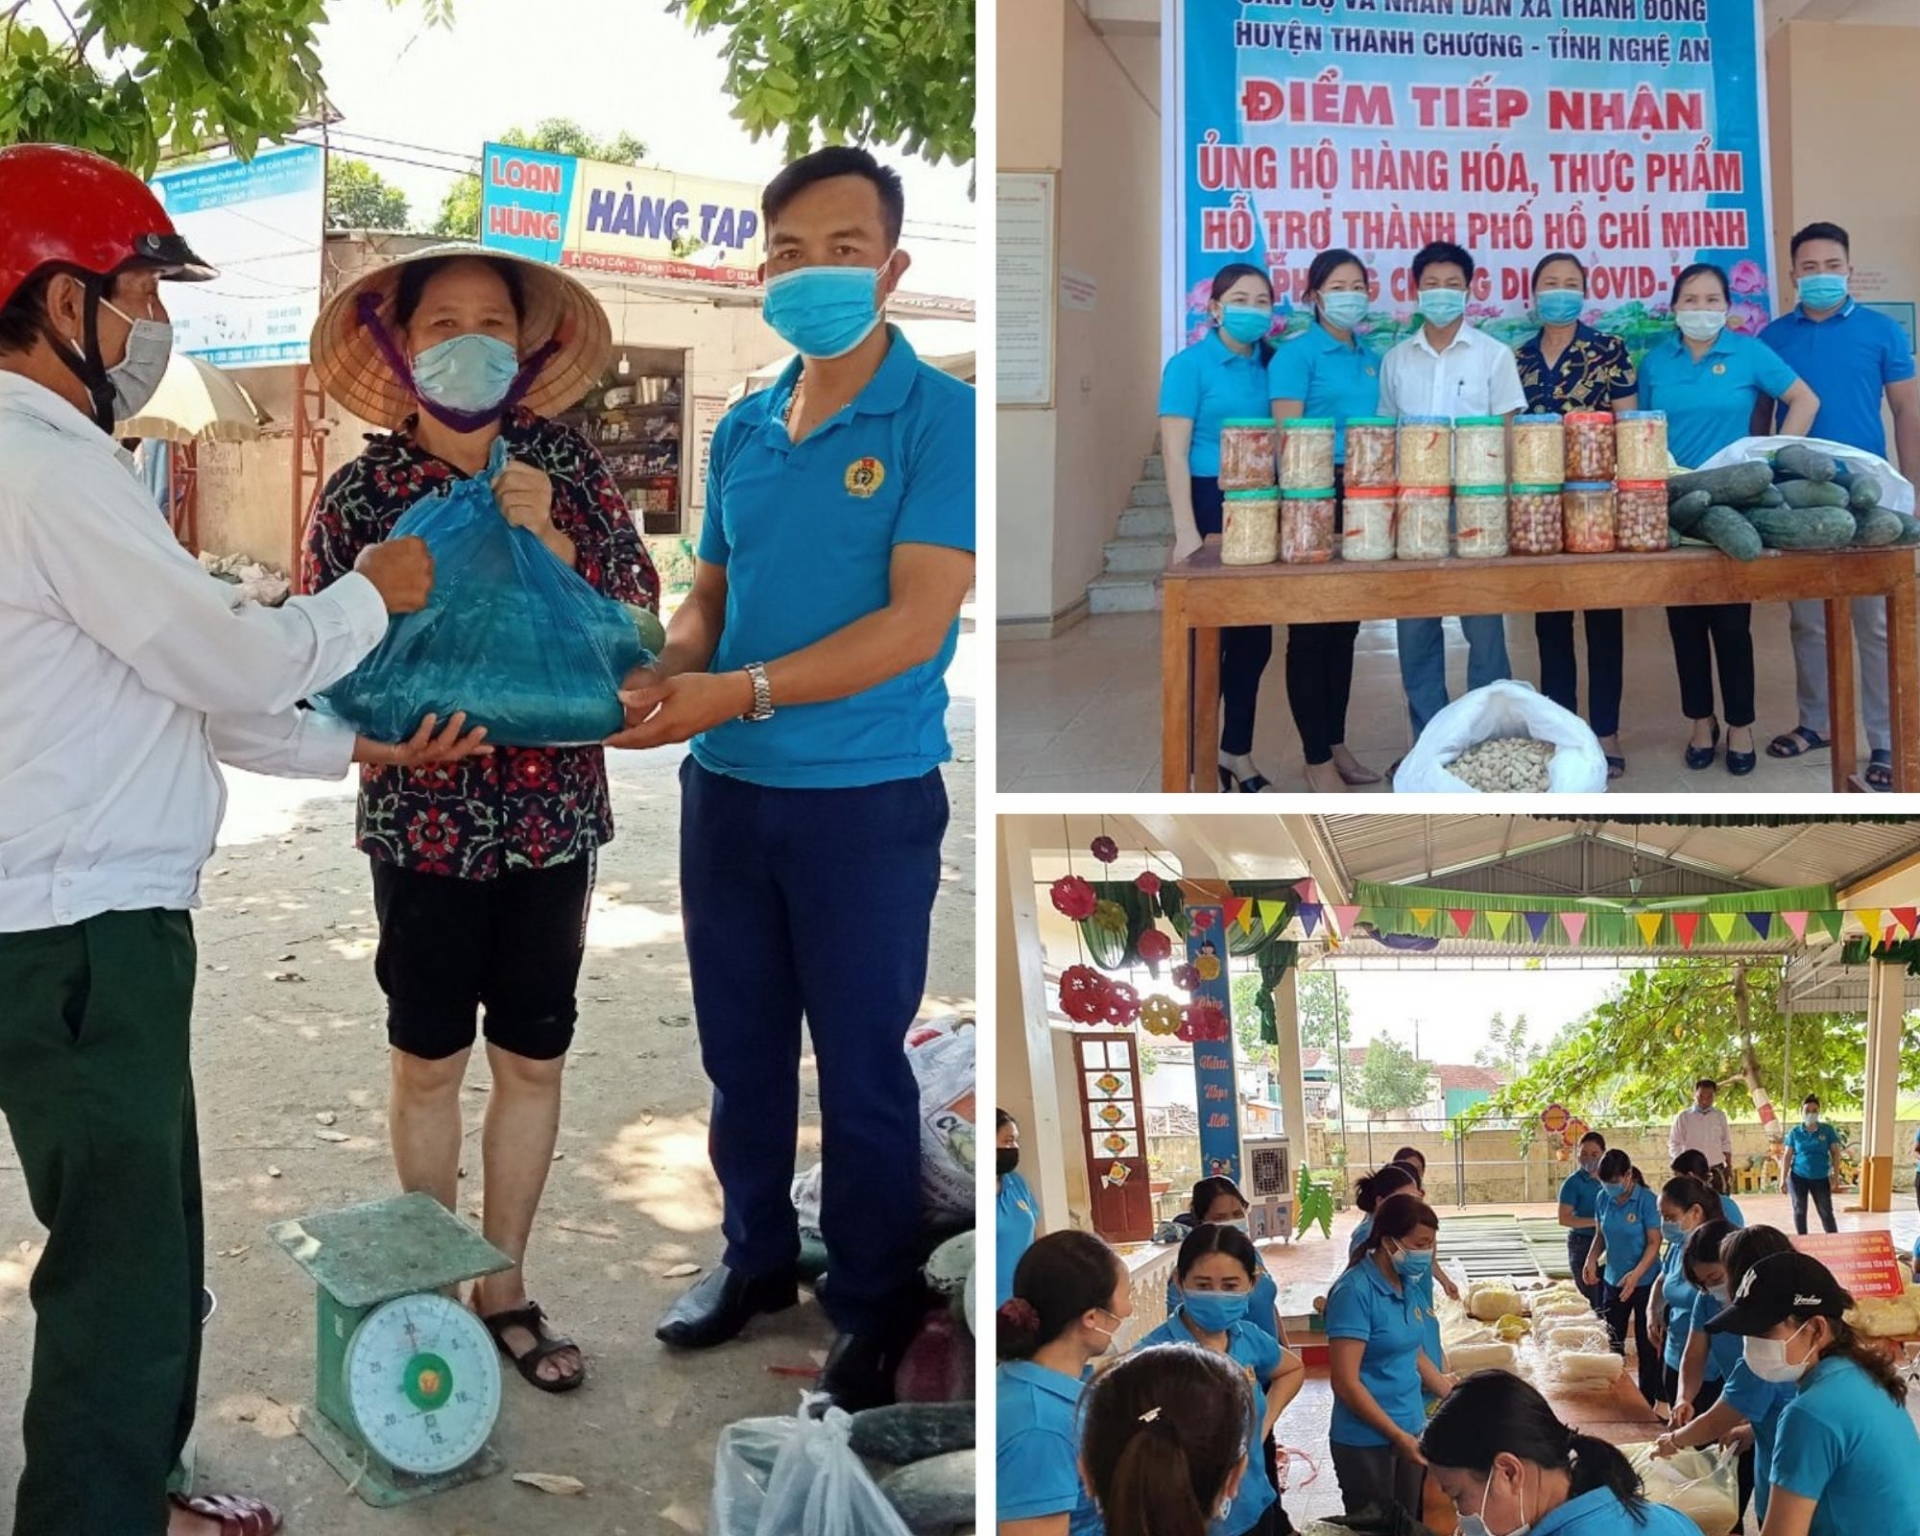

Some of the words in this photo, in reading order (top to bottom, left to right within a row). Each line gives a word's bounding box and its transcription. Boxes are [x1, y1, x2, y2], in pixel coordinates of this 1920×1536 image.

[1236, 20, 1322, 55] HUYỆN
[1331, 27, 1414, 54] THANH
[1423, 32, 1523, 58] CHƯƠNG
[1547, 28, 1600, 60] TỈNH
[1608, 34, 1671, 67] NGHỆ
[1678, 39, 1711, 62] AN
[1241, 68, 1394, 126] ĐIỂM
[1411, 75, 1529, 128] TIẾP
[1549, 85, 1704, 141] NHẬN
[491, 156, 562, 193] LOAN
[1199, 132, 1277, 190] ỦNG
[1290, 138, 1339, 199] HỘ
[1351, 140, 1449, 192] HÀNG
[1460, 142, 1539, 197] HÓA,
[1550, 149, 1635, 202] THỰC
[1646, 137, 1742, 192] PHẨM
[585, 180, 690, 242] HÀNG
[1204, 194, 1253, 250] HỖ
[1342, 203, 1456, 250] THÀNH
[1467, 199, 1534, 250] PHỐ
[1543, 200, 1588, 250] HỒ
[1597, 205, 1650, 250] CHÍ
[1660, 210, 1749, 249] MINH
[1272, 267, 1381, 303] PHG
